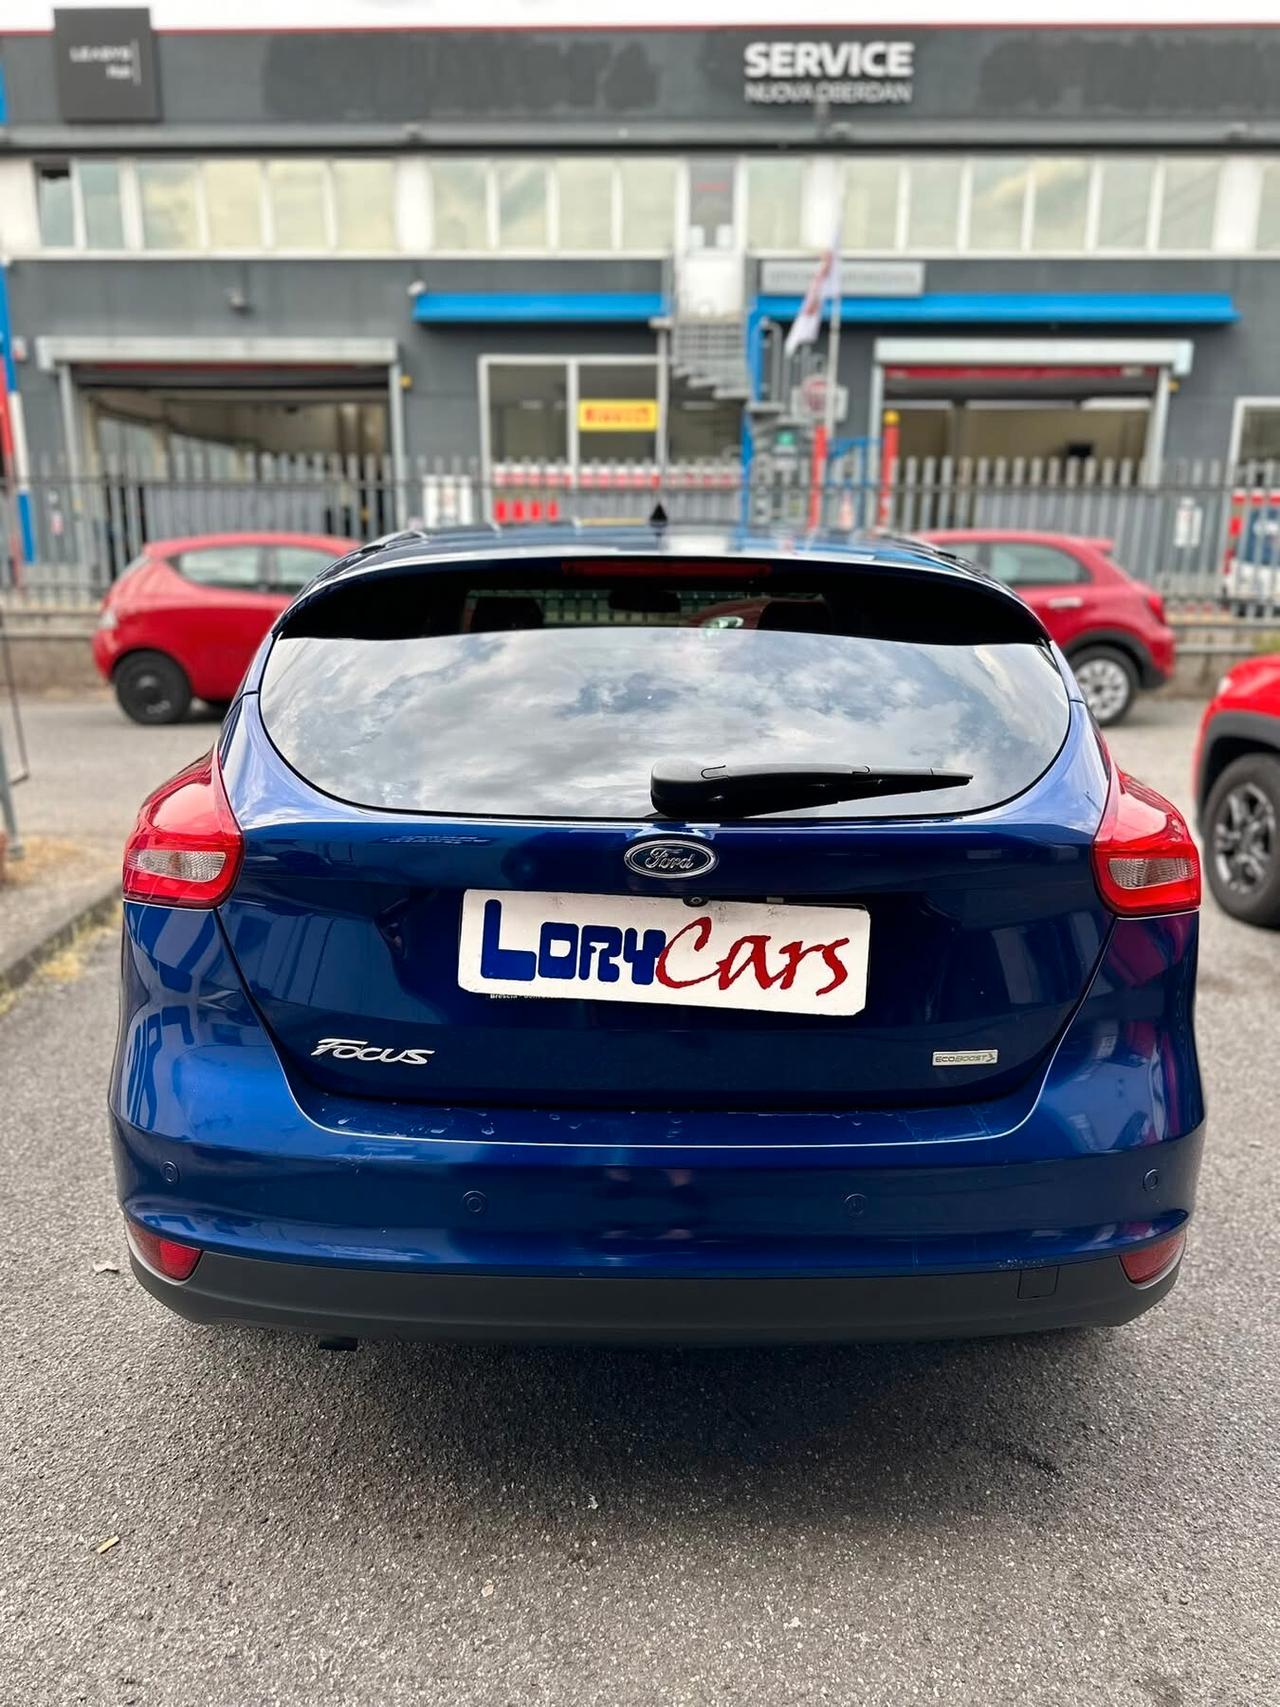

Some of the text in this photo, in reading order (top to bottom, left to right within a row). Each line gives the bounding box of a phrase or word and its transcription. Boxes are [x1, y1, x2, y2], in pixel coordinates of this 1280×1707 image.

[744, 41, 914, 78] SERVICE
[744, 82, 814, 103] NUOVA
[645, 847, 696, 869] Ford
